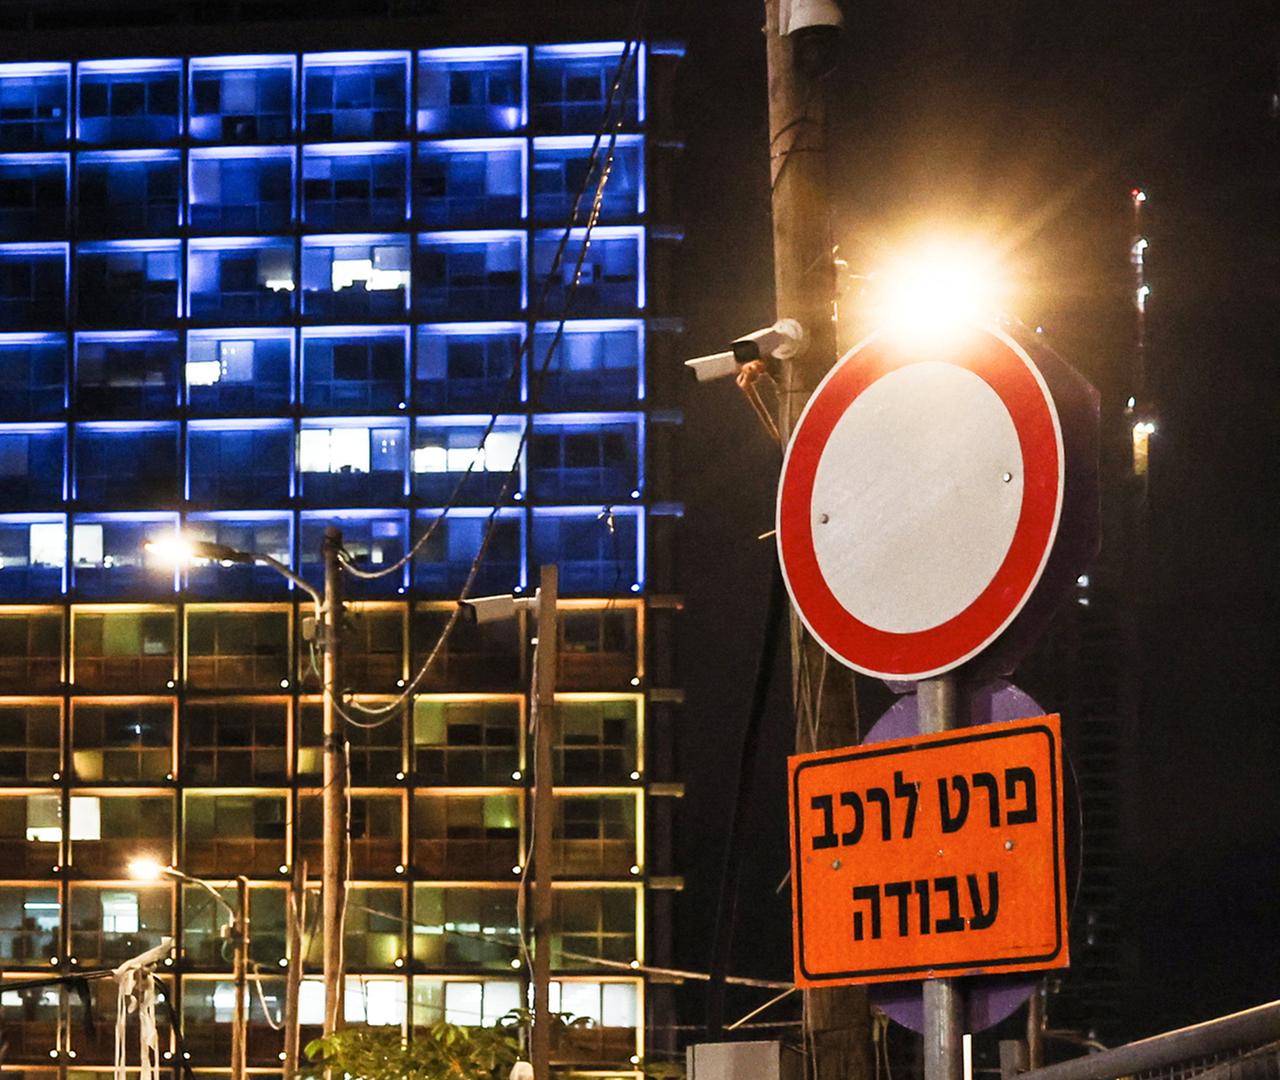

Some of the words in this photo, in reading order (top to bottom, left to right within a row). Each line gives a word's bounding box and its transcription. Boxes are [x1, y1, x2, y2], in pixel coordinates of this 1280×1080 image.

[811, 770, 922, 850] לרכב
[938, 766, 1038, 834] פרט
[852, 871, 1000, 941] עבודה
